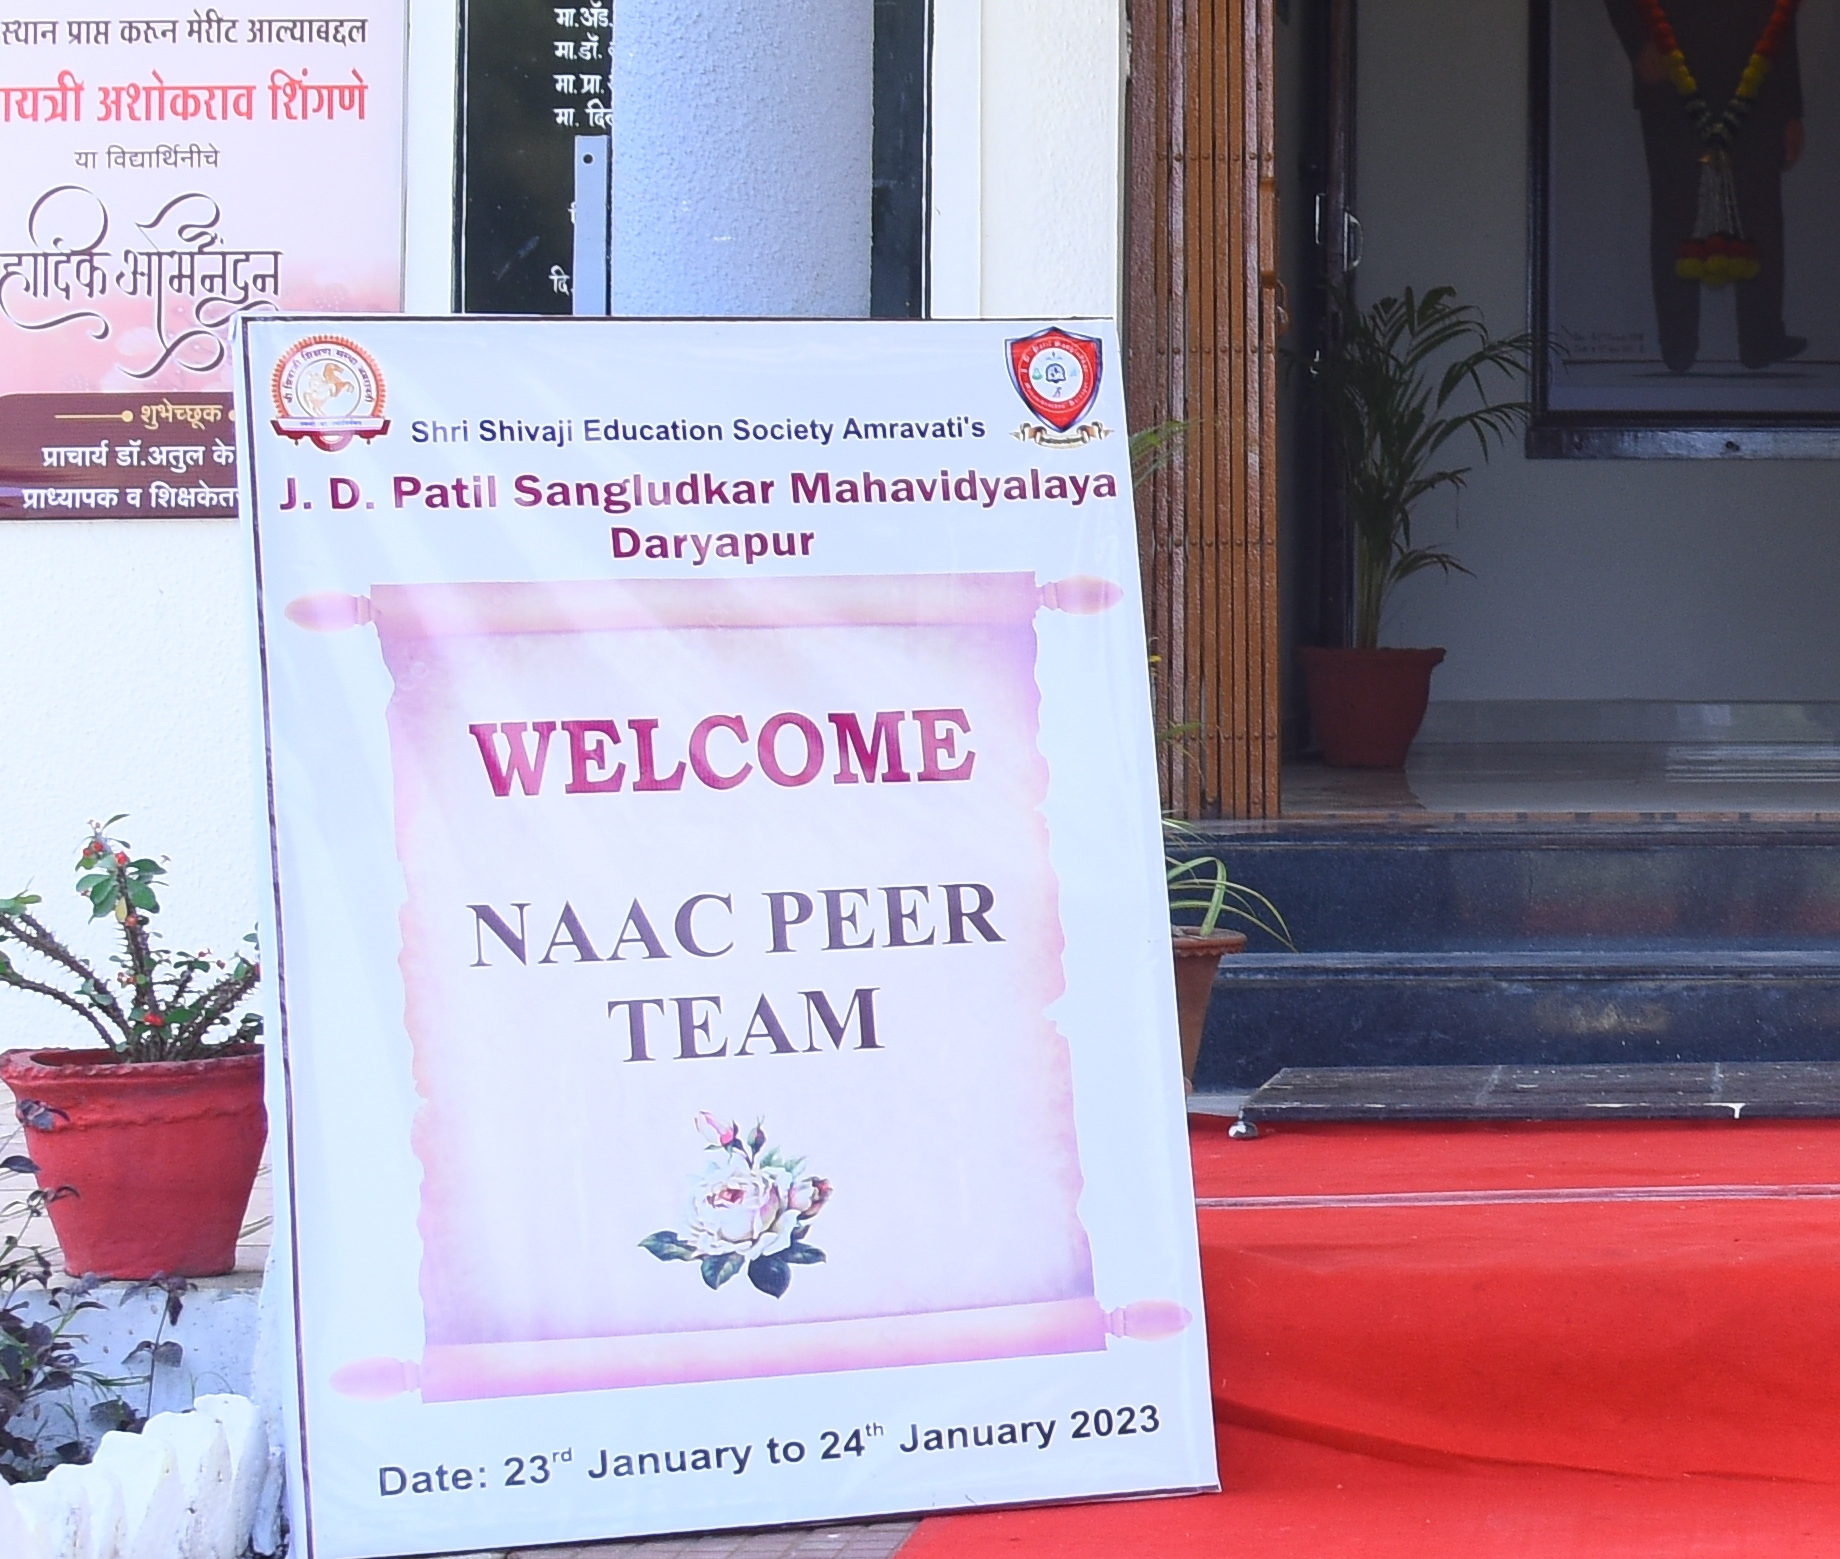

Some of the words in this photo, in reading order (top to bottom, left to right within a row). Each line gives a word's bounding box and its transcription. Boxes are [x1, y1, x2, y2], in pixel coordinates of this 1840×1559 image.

[1, 20, 59, 45] स्थान
[67, 19, 111, 45] प्राप्त
[119, 19, 179, 44] करून
[187, 8, 239, 45] मेरीट
[247, 16, 369, 48] आल्याबद्दल
[97, 68, 257, 122] अशोकराव
[268, 67, 370, 121] शिंगणे
[74, 149, 98, 169] या
[107, 142, 221, 169] विद्यार्थिनीचे
[41, 439, 110, 467] प्राचार्य
[411, 419, 469, 443] Shri
[479, 418, 573, 447] Shivaji
[583, 417, 724, 441] Education
[733, 417, 835, 446] Society
[843, 416, 987, 441] Amravati's
[22, 486, 120, 509] प्राध्यापक
[126, 488, 143, 508] व
[149, 480, 240, 509] शिक्षकेत
[279, 477, 313, 511] J.
[329, 477, 376, 510] D.
[393, 474, 498, 509] Patil
[513, 472, 775, 515] Sangludkar
[790, 467, 1118, 509] Mahavidyalaya
[610, 527, 816, 567] Daryapur
[469, 708, 976, 797] WELCOME
[466, 892, 735, 967] NAAC
[761, 883, 1007, 954] PEER
[607, 987, 886, 1063] TEAM
[379, 1463, 489, 1497] Date:
[502, 1445, 574, 1488] 23rd
[588, 1441, 753, 1481] January
[767, 1437, 807, 1464] to
[820, 1420, 886, 1462] 24th
[898, 1415, 1058, 1455] January
[1069, 1402, 1162, 1439] 2023
